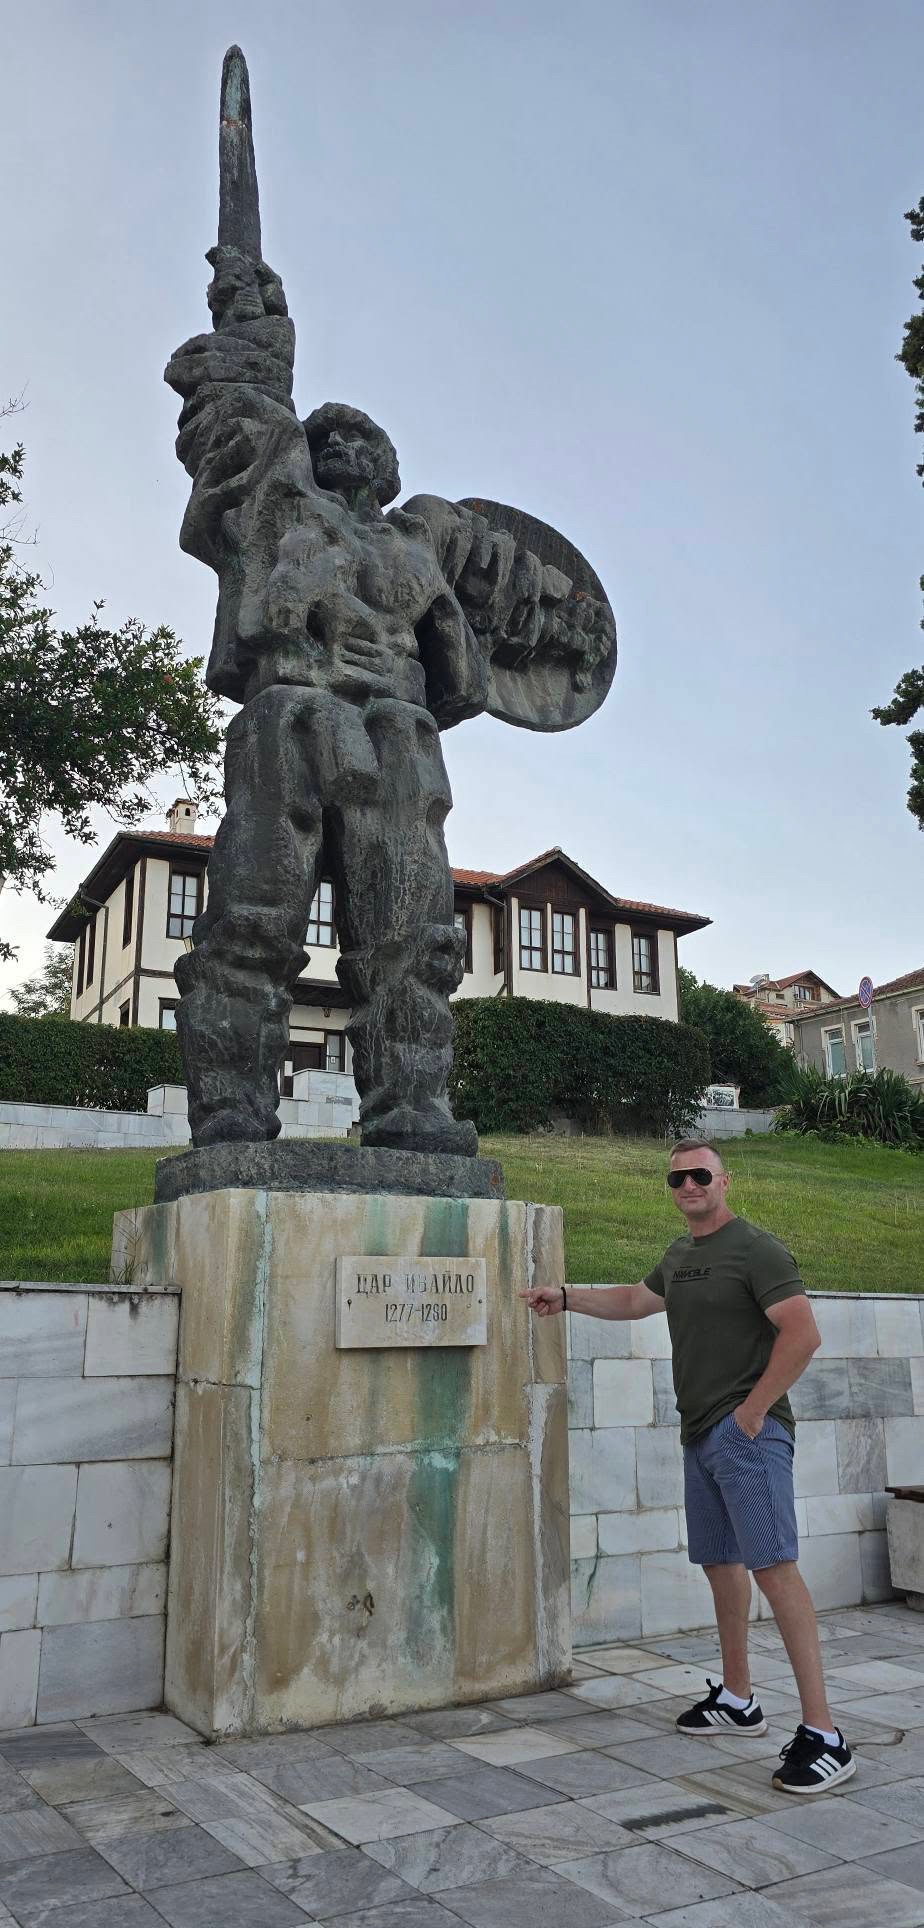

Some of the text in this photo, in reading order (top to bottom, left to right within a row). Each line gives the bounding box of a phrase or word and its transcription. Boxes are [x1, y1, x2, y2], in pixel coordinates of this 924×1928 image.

[356, 1271, 474, 1297] ЦАР ИВАЙЛО
[385, 1303, 448, 1322] 1277-1280
